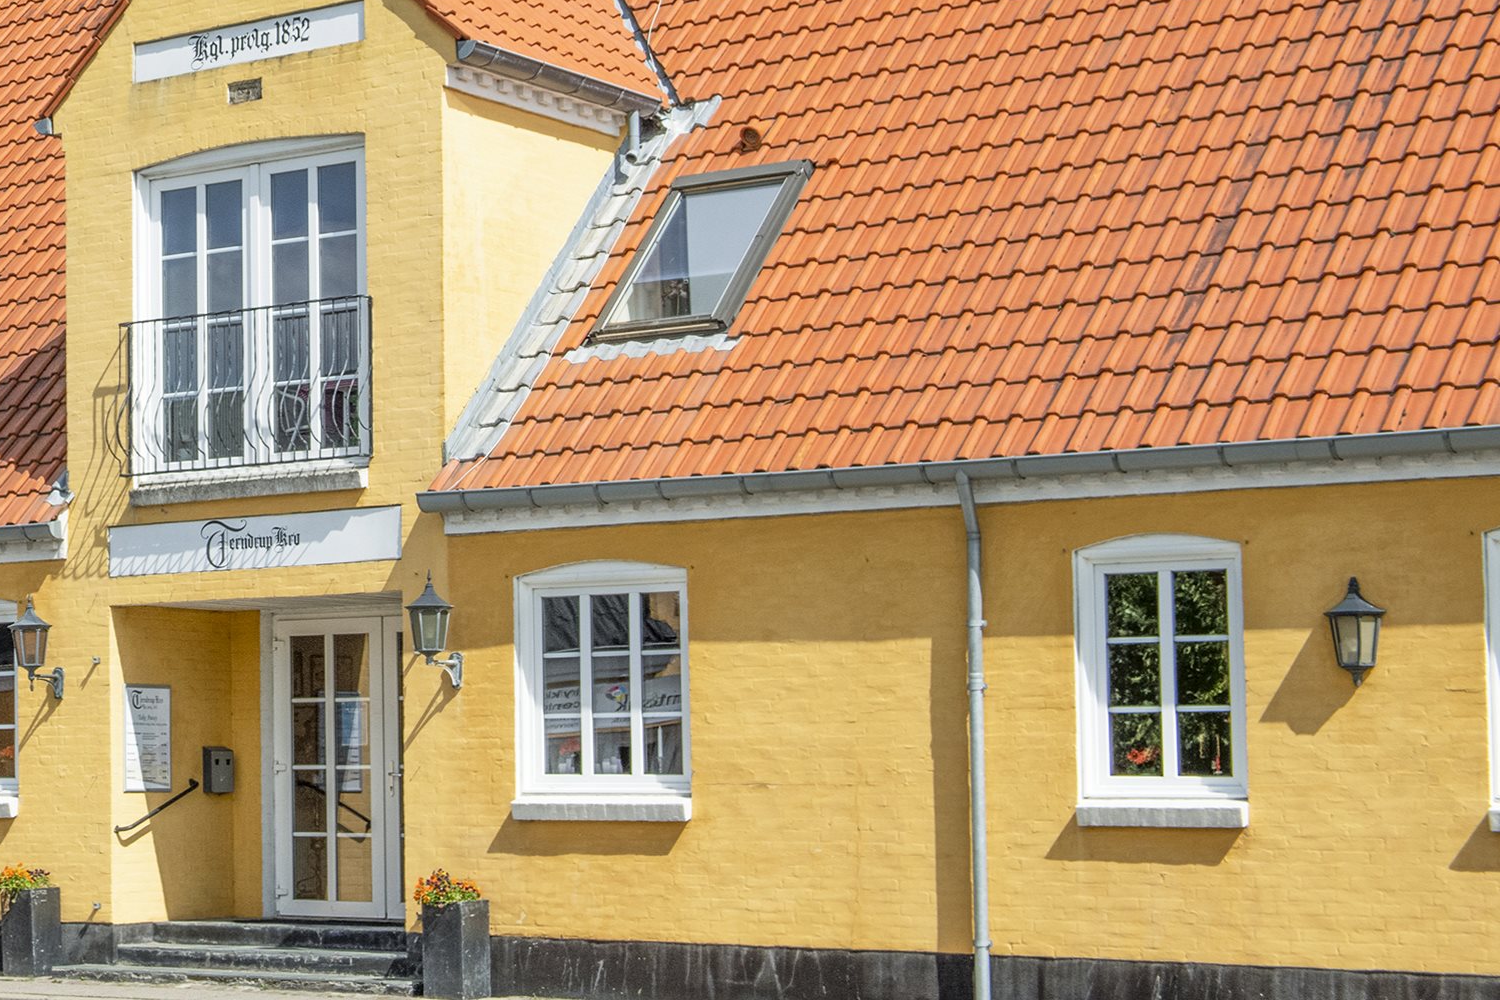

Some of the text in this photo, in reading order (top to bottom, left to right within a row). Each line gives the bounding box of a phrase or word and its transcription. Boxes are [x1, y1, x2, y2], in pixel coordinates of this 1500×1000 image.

[274, 16, 311, 46] 1852
[201, 519, 300, 568] Terndrup Kro
